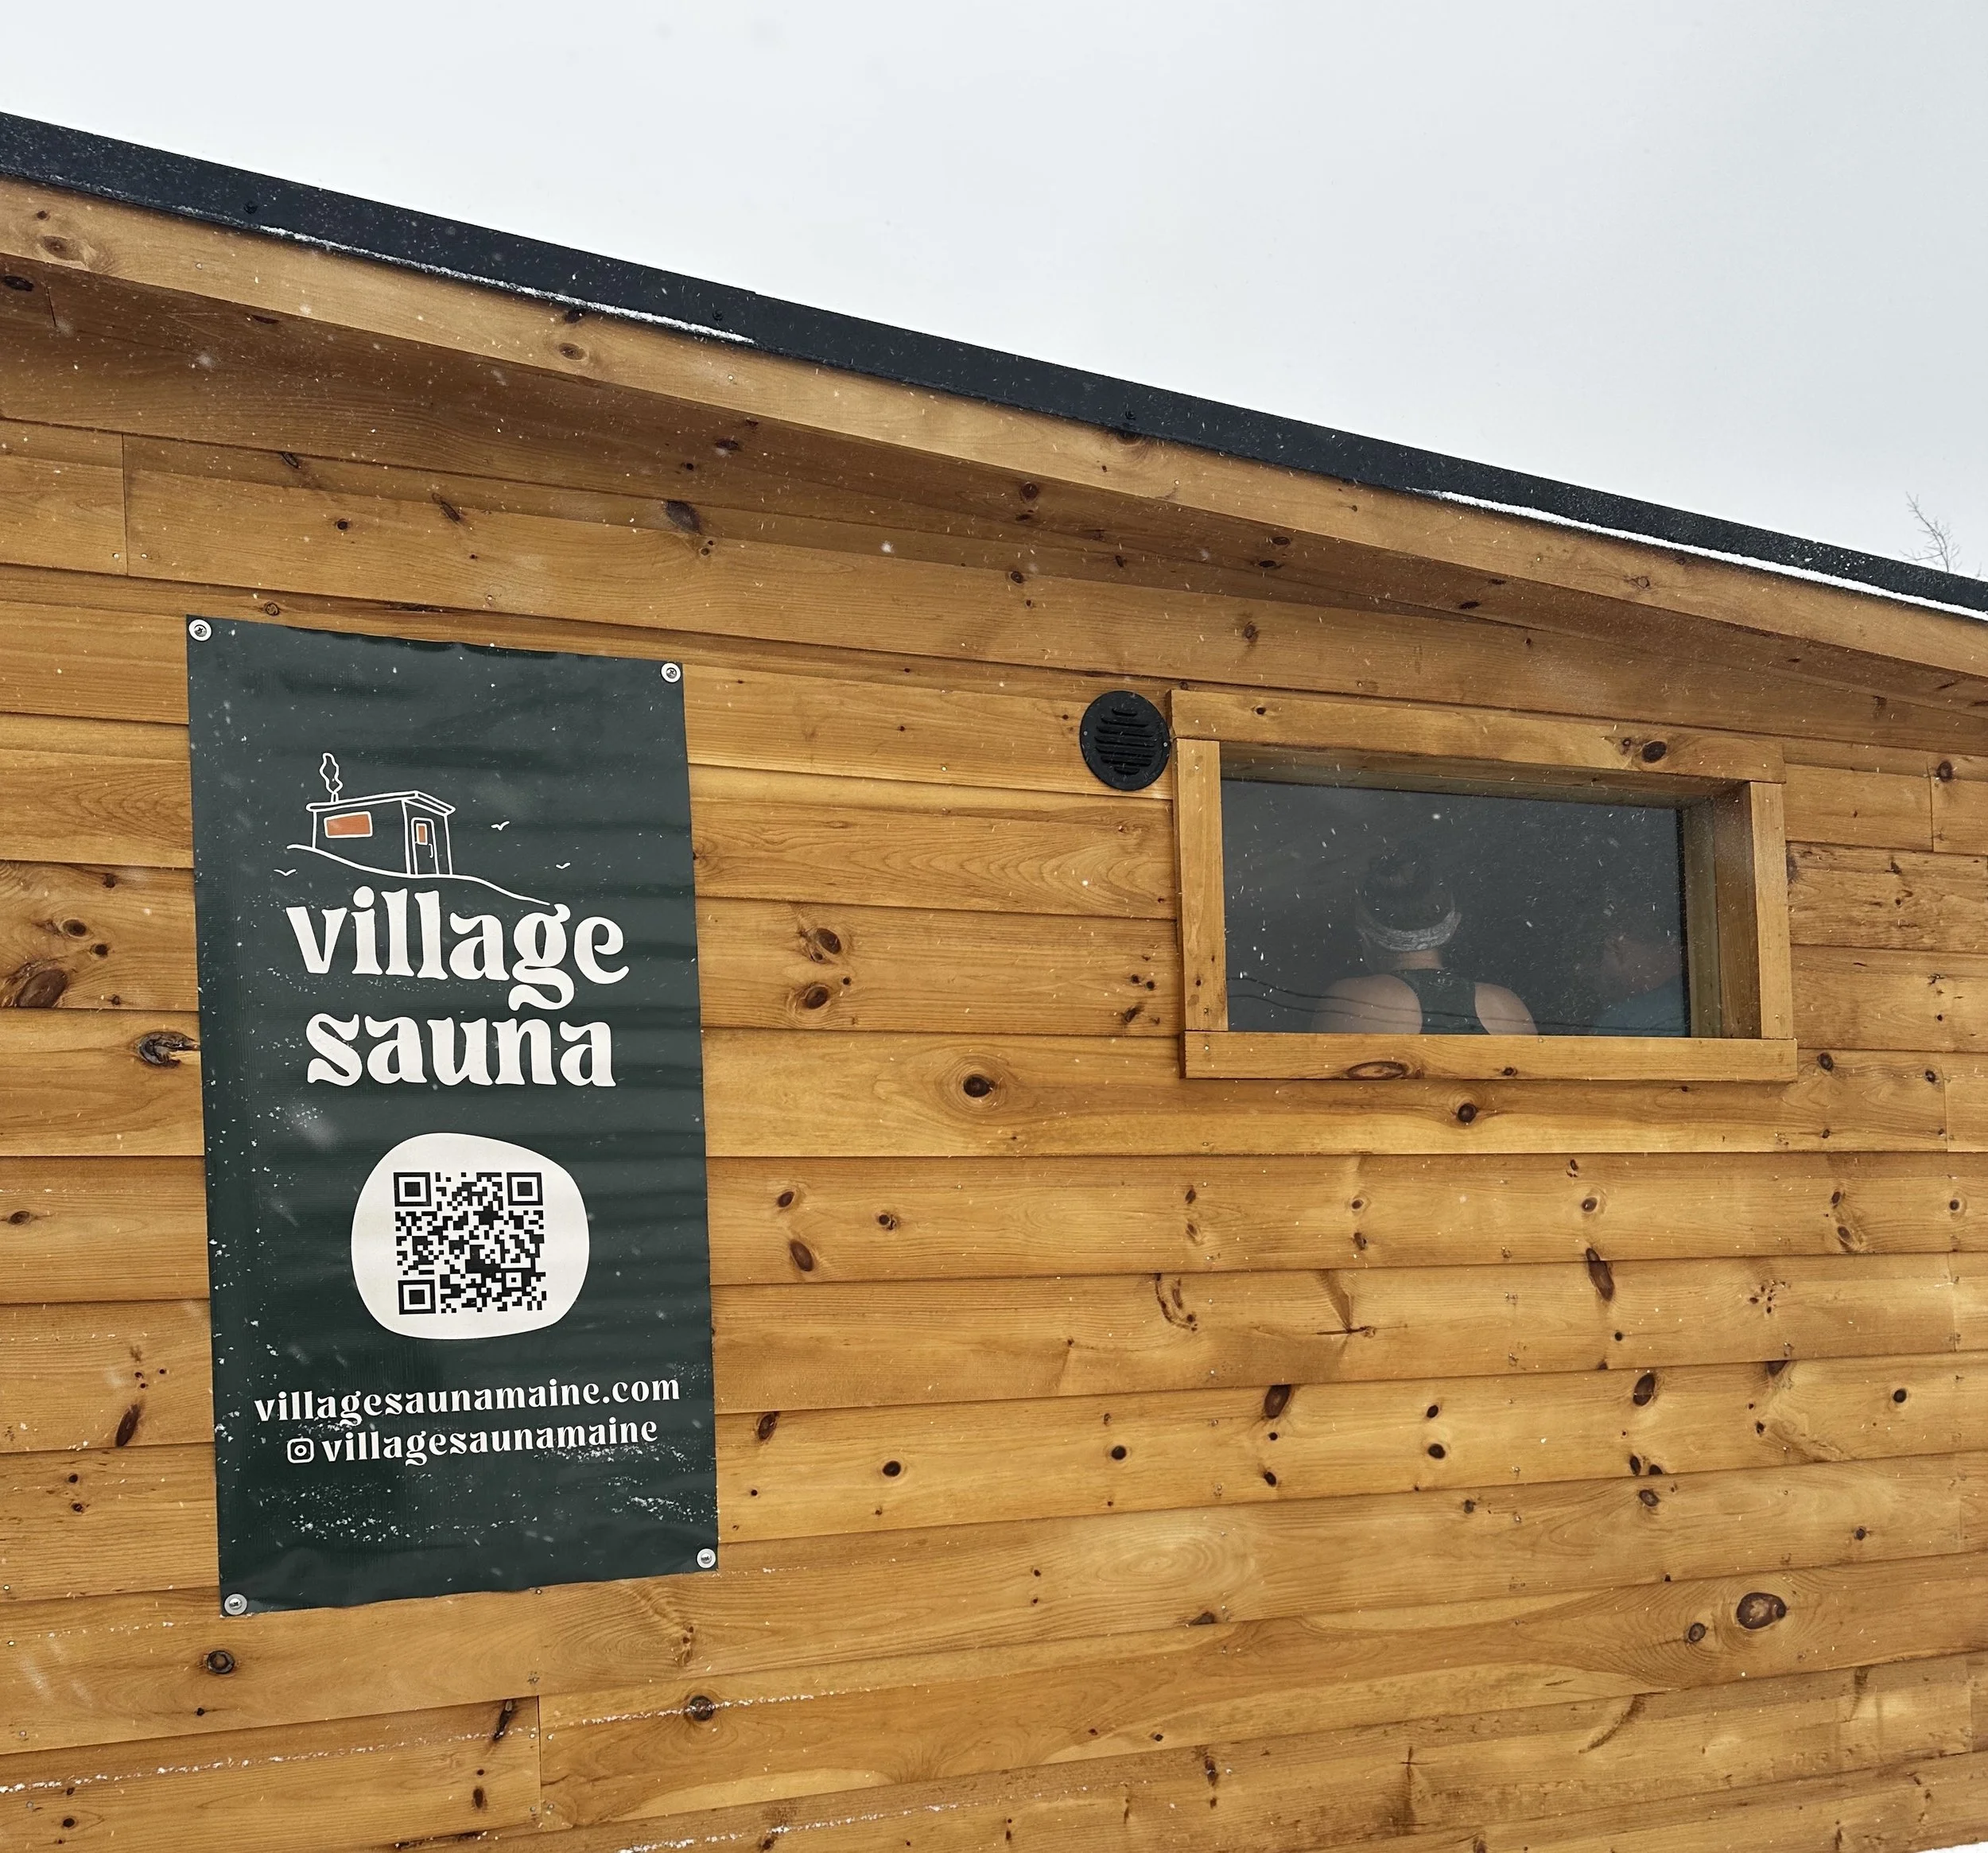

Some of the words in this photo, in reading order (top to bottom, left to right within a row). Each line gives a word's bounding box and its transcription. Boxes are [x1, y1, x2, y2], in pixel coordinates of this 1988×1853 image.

[285, 885, 630, 1012] village
[305, 1012, 617, 1087] sauna
[254, 1378, 681, 1430] villagesaunamaine.com
[321, 1416, 658, 1466] villagesaunamaine
